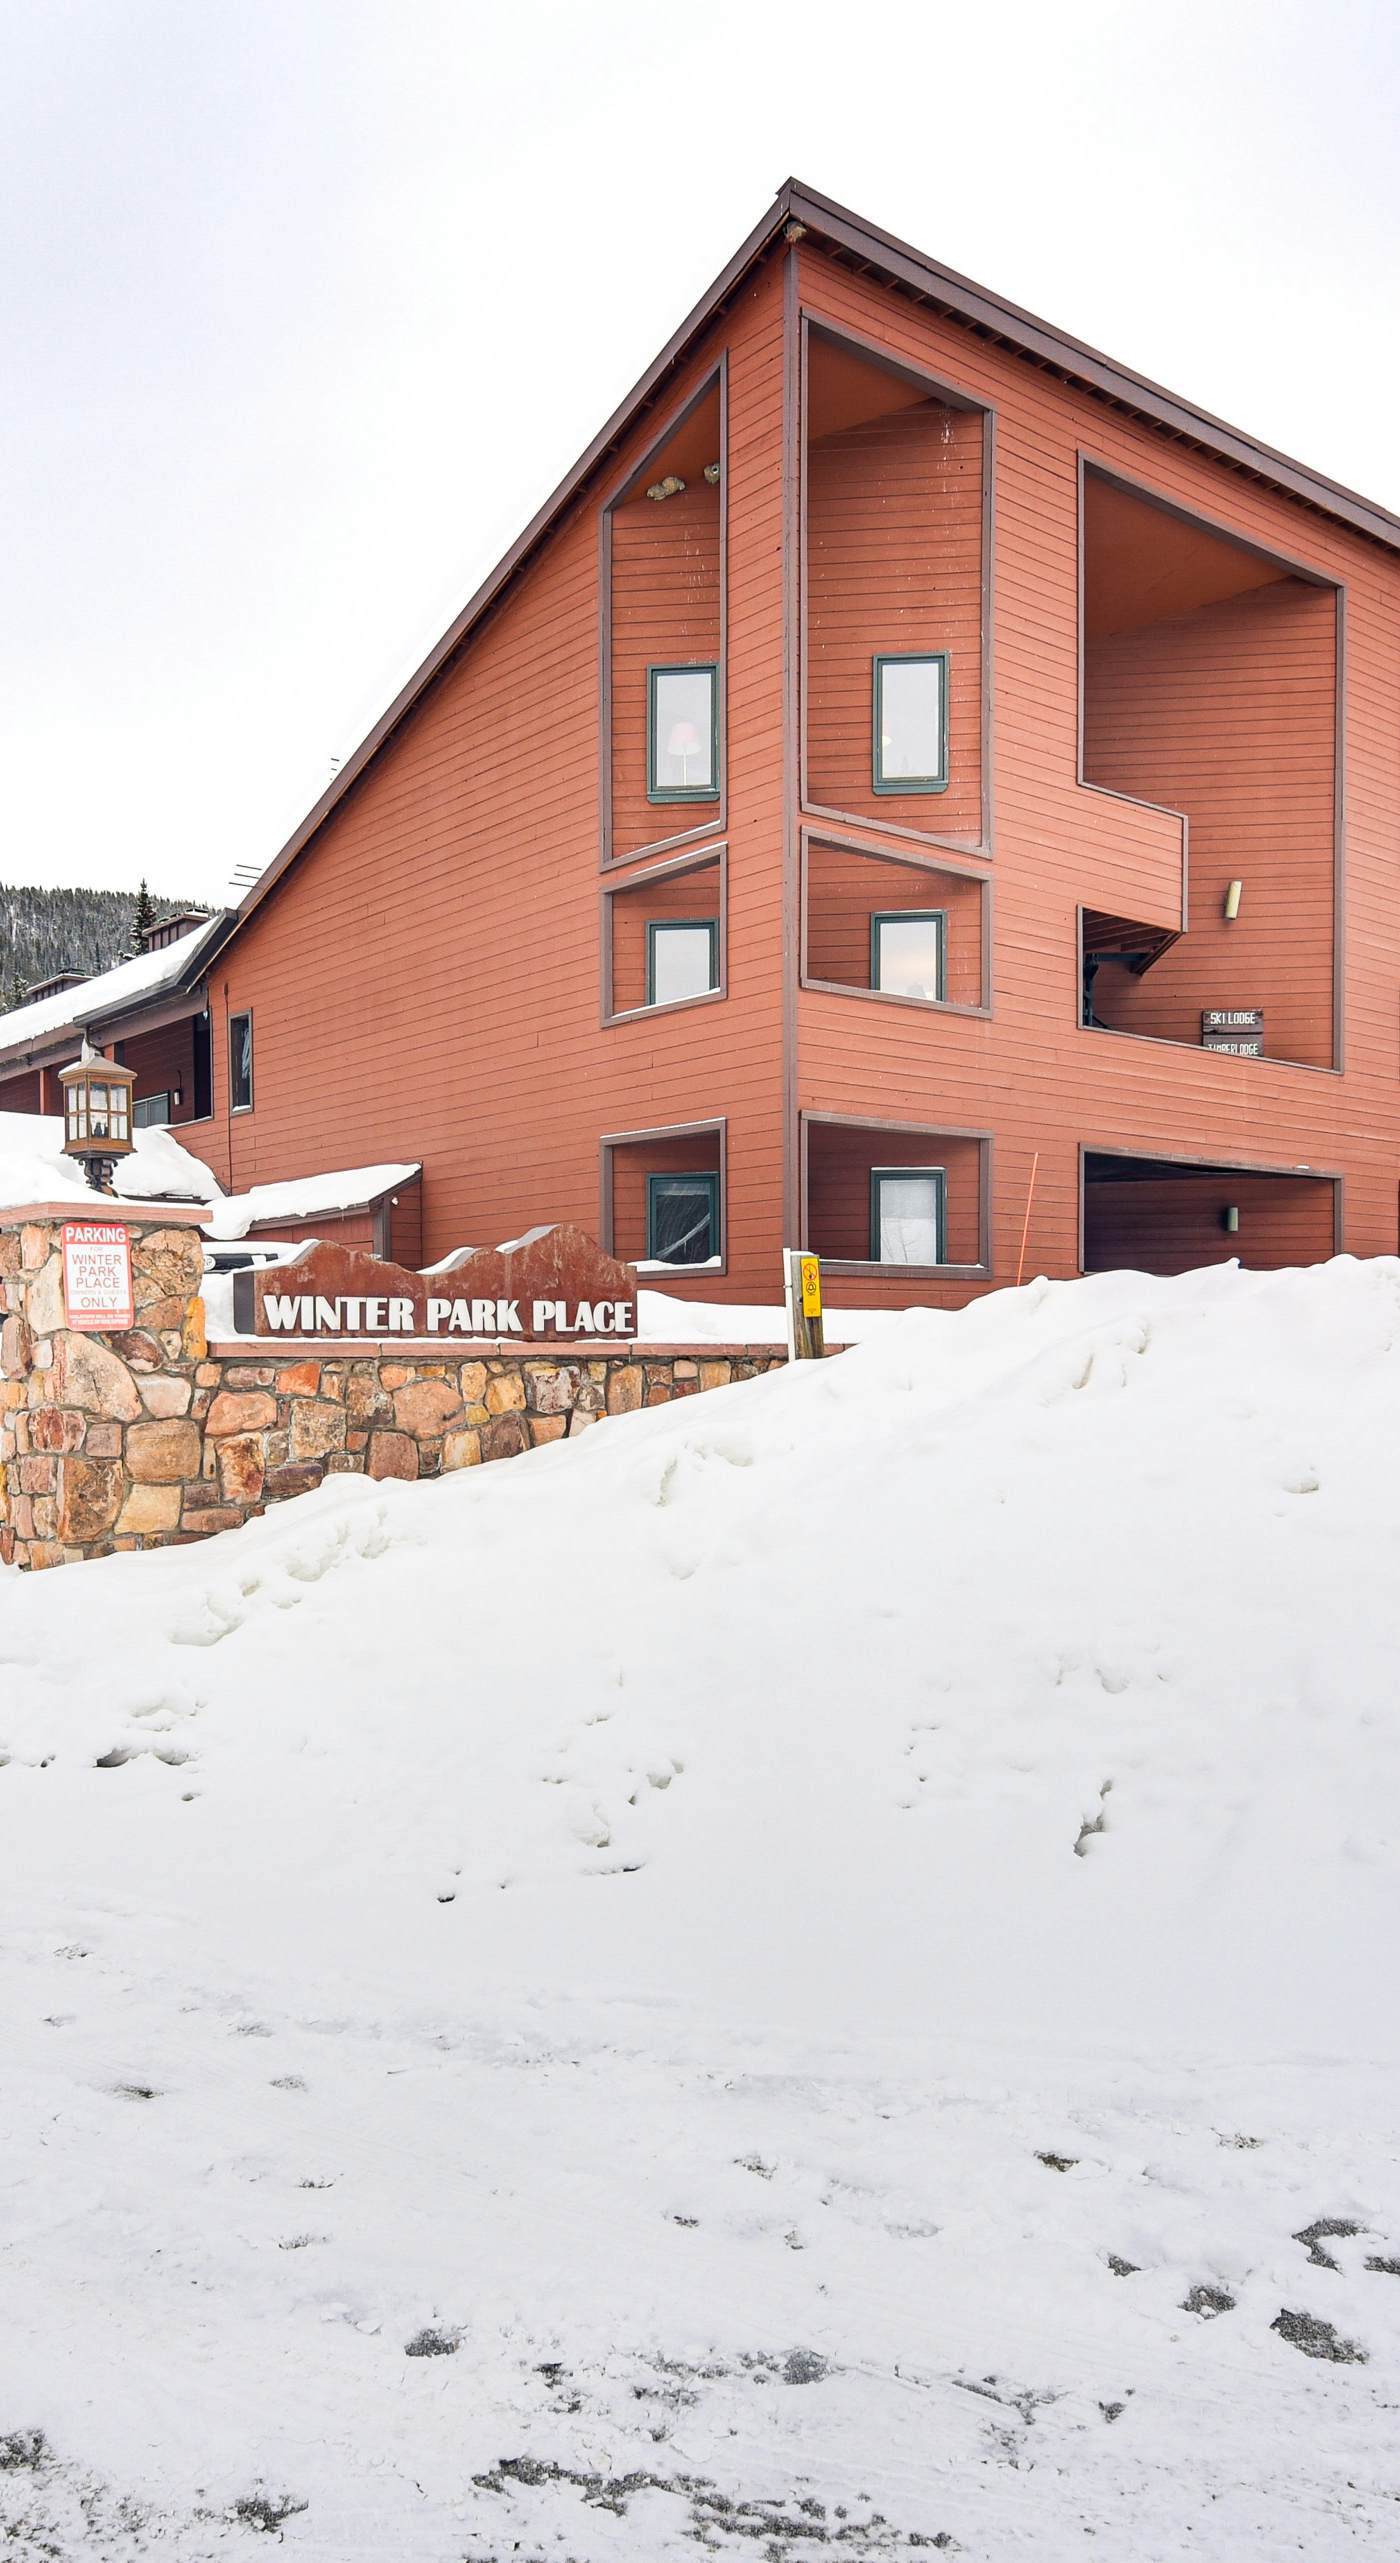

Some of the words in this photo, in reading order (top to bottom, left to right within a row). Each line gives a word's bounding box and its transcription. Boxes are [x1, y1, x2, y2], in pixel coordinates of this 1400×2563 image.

[1210, 1012, 1226, 1025] SKI
[1228, 1012, 1256, 1025] LODGE
[66, 1226, 126, 1243] PARKING
[72, 1254, 122, 1265] WINTER
[79, 1266, 117, 1277] PARK
[75, 1277, 120, 1288] PLACE
[80, 1297, 118, 1308] ONLY
[262, 1294, 415, 1333] WINTER
[426, 1298, 523, 1333] PARK
[532, 1300, 634, 1333] PLACE
